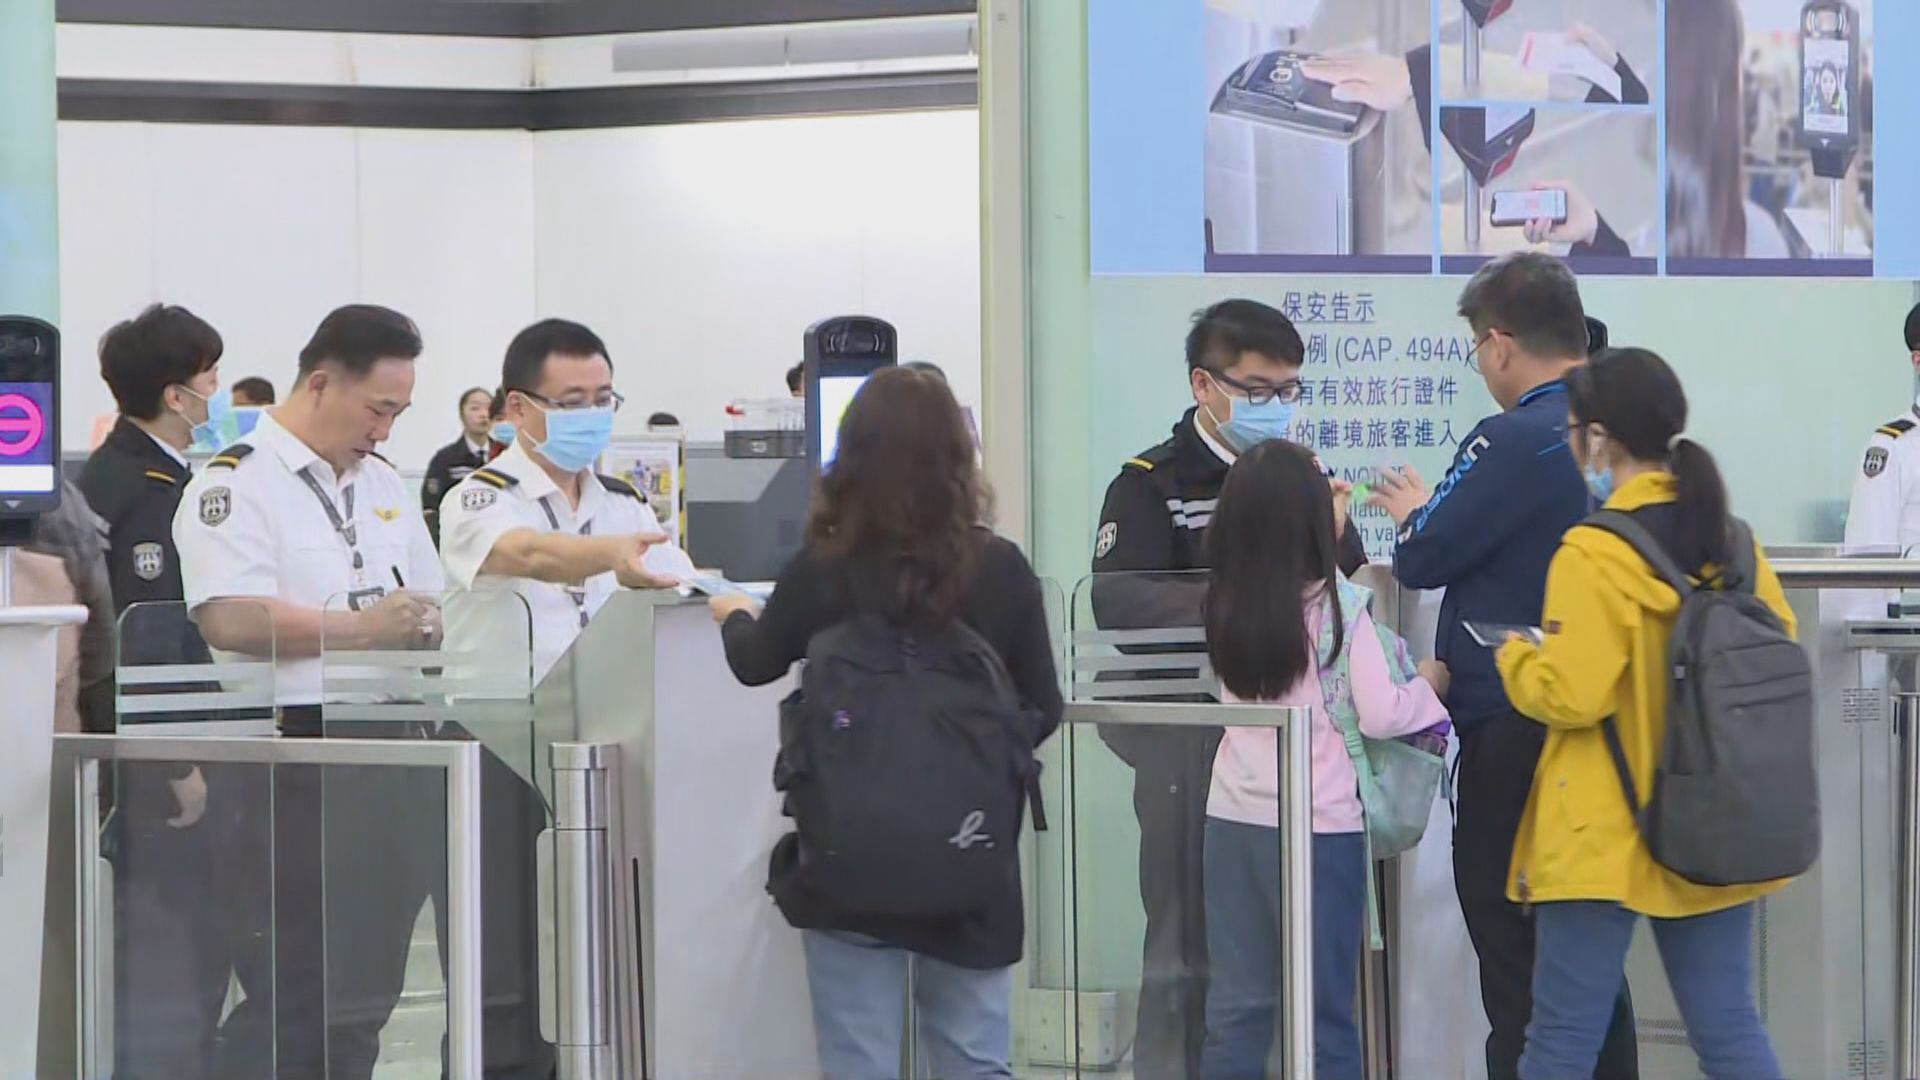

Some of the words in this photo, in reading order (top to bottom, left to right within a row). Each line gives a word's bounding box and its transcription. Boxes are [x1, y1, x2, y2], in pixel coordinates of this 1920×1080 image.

[1283, 292, 1375, 321] 保安告示
[1307, 333, 1328, 364] 例
